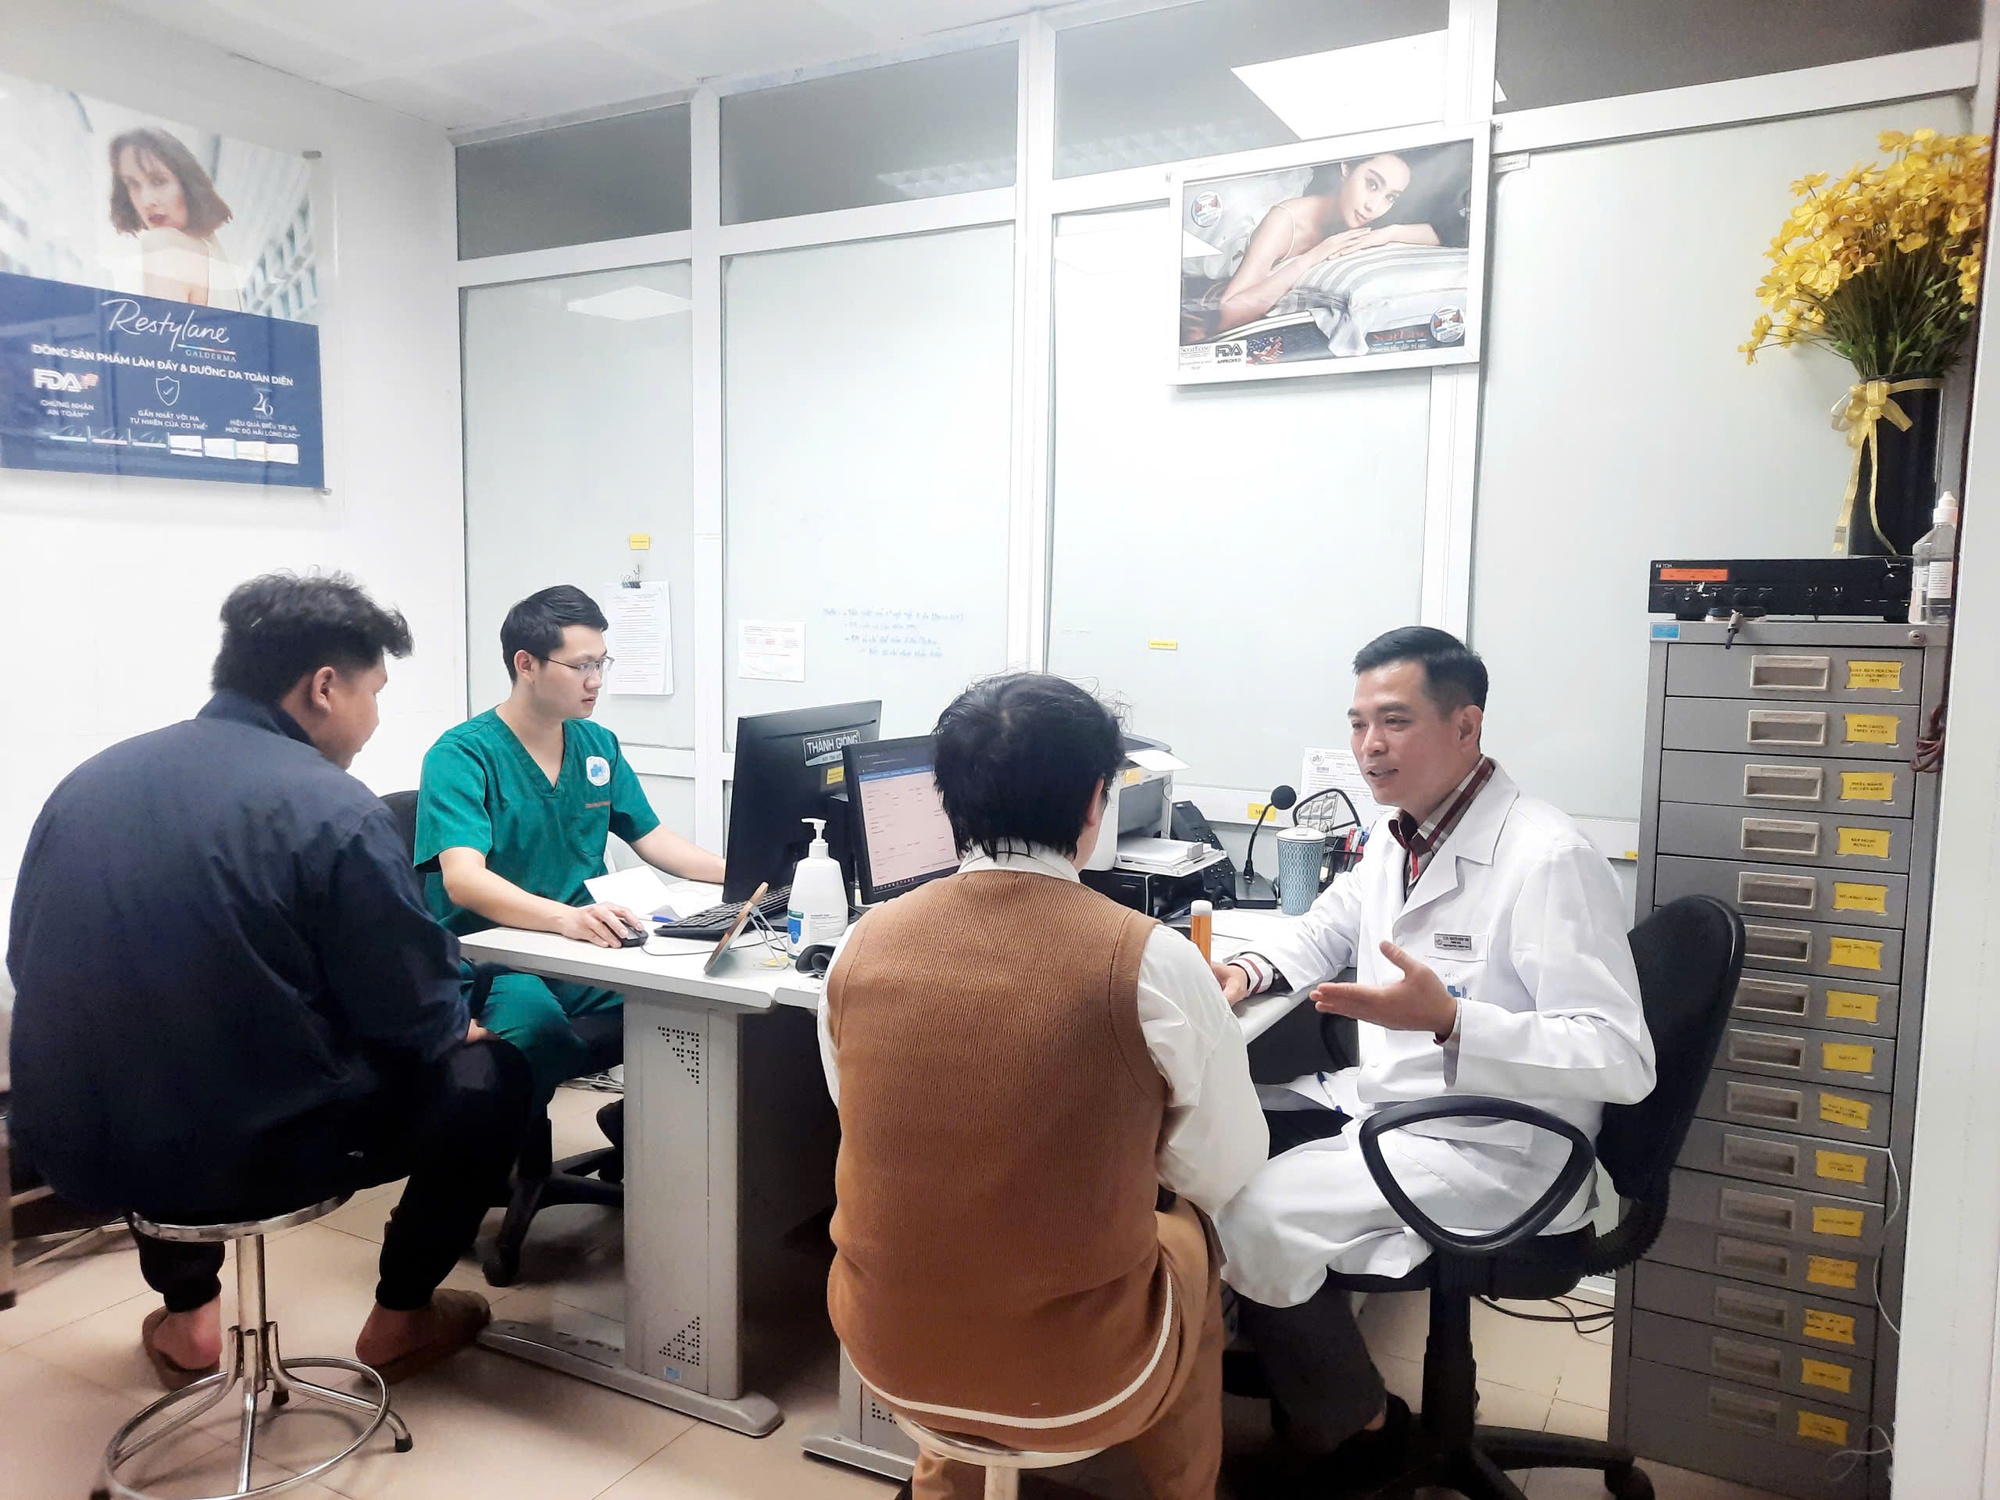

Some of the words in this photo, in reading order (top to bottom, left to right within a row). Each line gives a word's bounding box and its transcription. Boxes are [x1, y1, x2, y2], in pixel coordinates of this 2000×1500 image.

[101, 298, 230, 352] Restylane
[185, 350, 237, 363] GALDERMA
[1215, 343, 1243, 357] FDA
[31, 344, 69, 358] DÒNG
[132, 356, 155, 369] LÀM
[180, 363, 187, 372] &
[228, 370, 242, 380] DA
[244, 372, 270, 384] TOÀN
[33, 368, 82, 393] FDA
